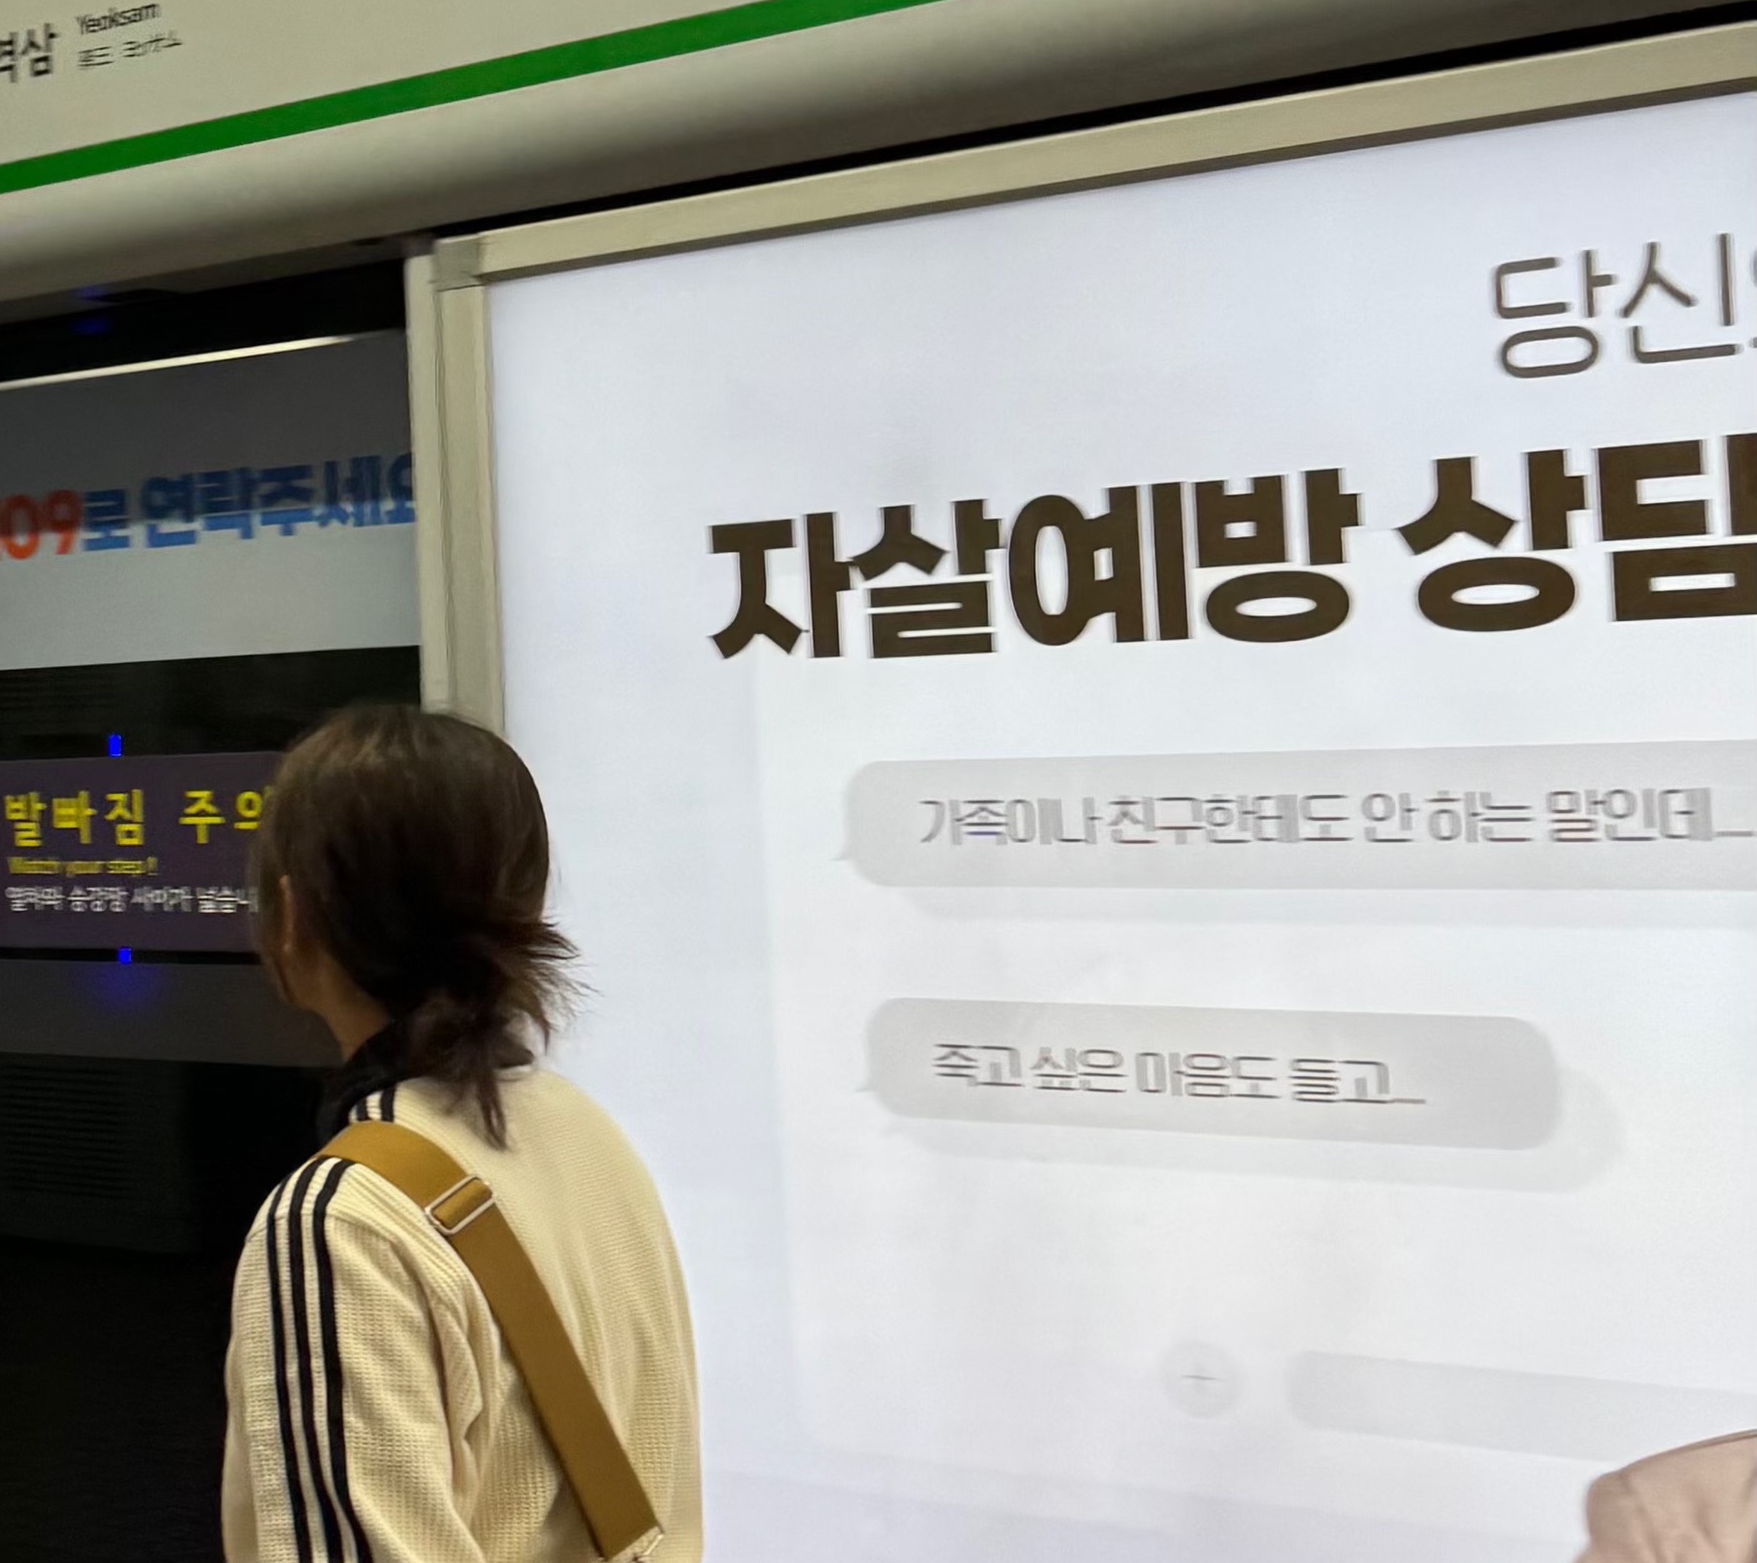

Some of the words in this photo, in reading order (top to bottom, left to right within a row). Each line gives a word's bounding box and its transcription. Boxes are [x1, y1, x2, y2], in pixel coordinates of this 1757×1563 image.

[75, 3, 161, 36] Yeoksam
[1493, 232, 1757, 379] 당신
[708, 466, 1366, 661] 자살예방
[920, 795, 1104, 846] 가족이나
[1107, 791, 1353, 845] 친구한테도
[1360, 791, 1420, 844] 안
[1424, 789, 1534, 844] 하는
[66, 886, 130, 913] 승강장
[195, 886, 259, 914] 넓습니
[933, 1043, 1024, 1088] 죽고
[1030, 1046, 1128, 1094] 싶은
[1134, 1050, 1284, 1100] 마음도
